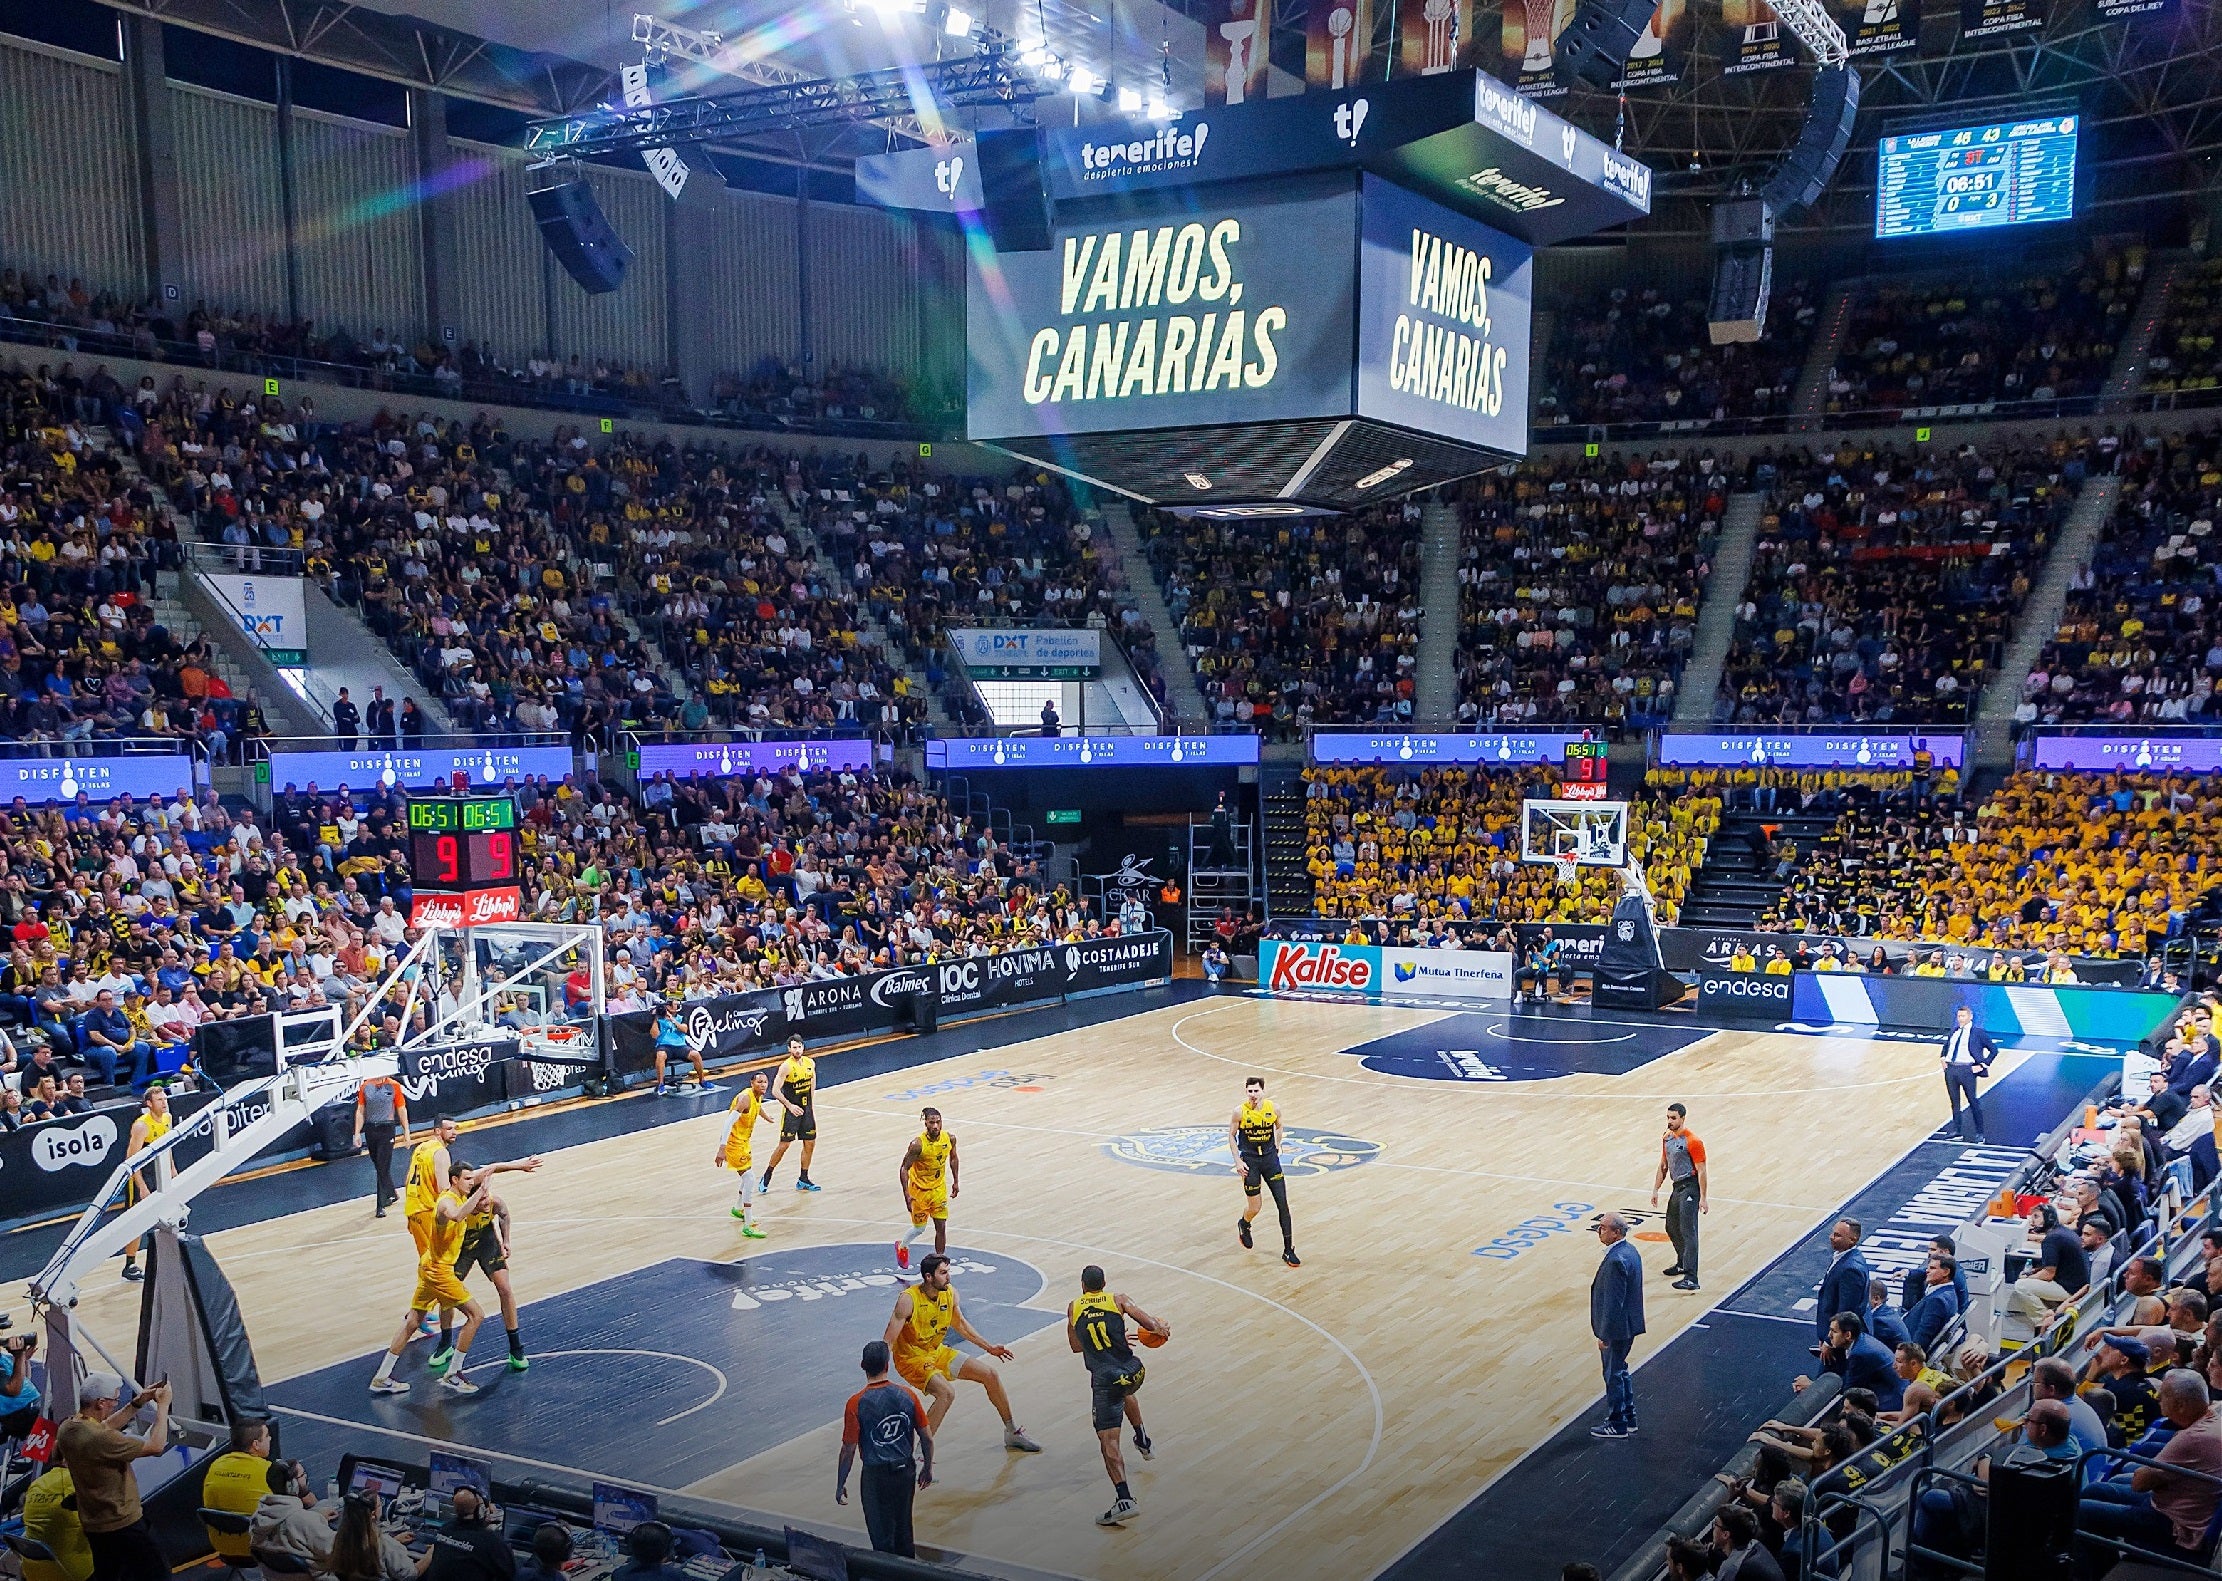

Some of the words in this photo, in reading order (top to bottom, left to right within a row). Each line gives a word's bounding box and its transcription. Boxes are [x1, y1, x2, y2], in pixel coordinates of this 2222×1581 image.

[1081, 121, 1209, 171] tenerife!
[1946, 173, 1993, 194] 06:51
[1947, 196, 1960, 212] 0
[1984, 193, 1997, 209] 3
[1060, 218, 1244, 316] VAMOS,
[1410, 227, 1492, 336] VAMOS,
[1022, 304, 1288, 405] CANARIAS
[243, 614, 284, 633] DXT
[993, 634, 1029, 650] DXT
[1036, 648, 1050, 660] de
[411, 803, 459, 828] 06:51
[463, 803, 512, 828] 06:51
[436, 835, 459, 882] 9
[488, 832, 511, 878] 9
[468, 892, 516, 922] Libby's
[1705, 941, 1778, 957] ARAS
[939, 961, 979, 994] IOC
[987, 950, 1056, 980] HOVIMA
[1099, 963, 1126, 973] TENERIFE
[1272, 943, 1370, 991] Kalise
[1418, 965, 1451, 978] Mutua
[961, 989, 982, 1001] Dental
[1014, 976, 1034, 989] HOTELS
[1704, 976, 1789, 999] endesa
[807, 984, 862, 1008] ARONA
[418, 1045, 492, 1075] endesa
[47, 1130, 104, 1161] isola
[1471, 1201, 1595, 1260] endesa
[1086, 1321, 1112, 1351] 11
[882, 1419, 901, 1439] 27
